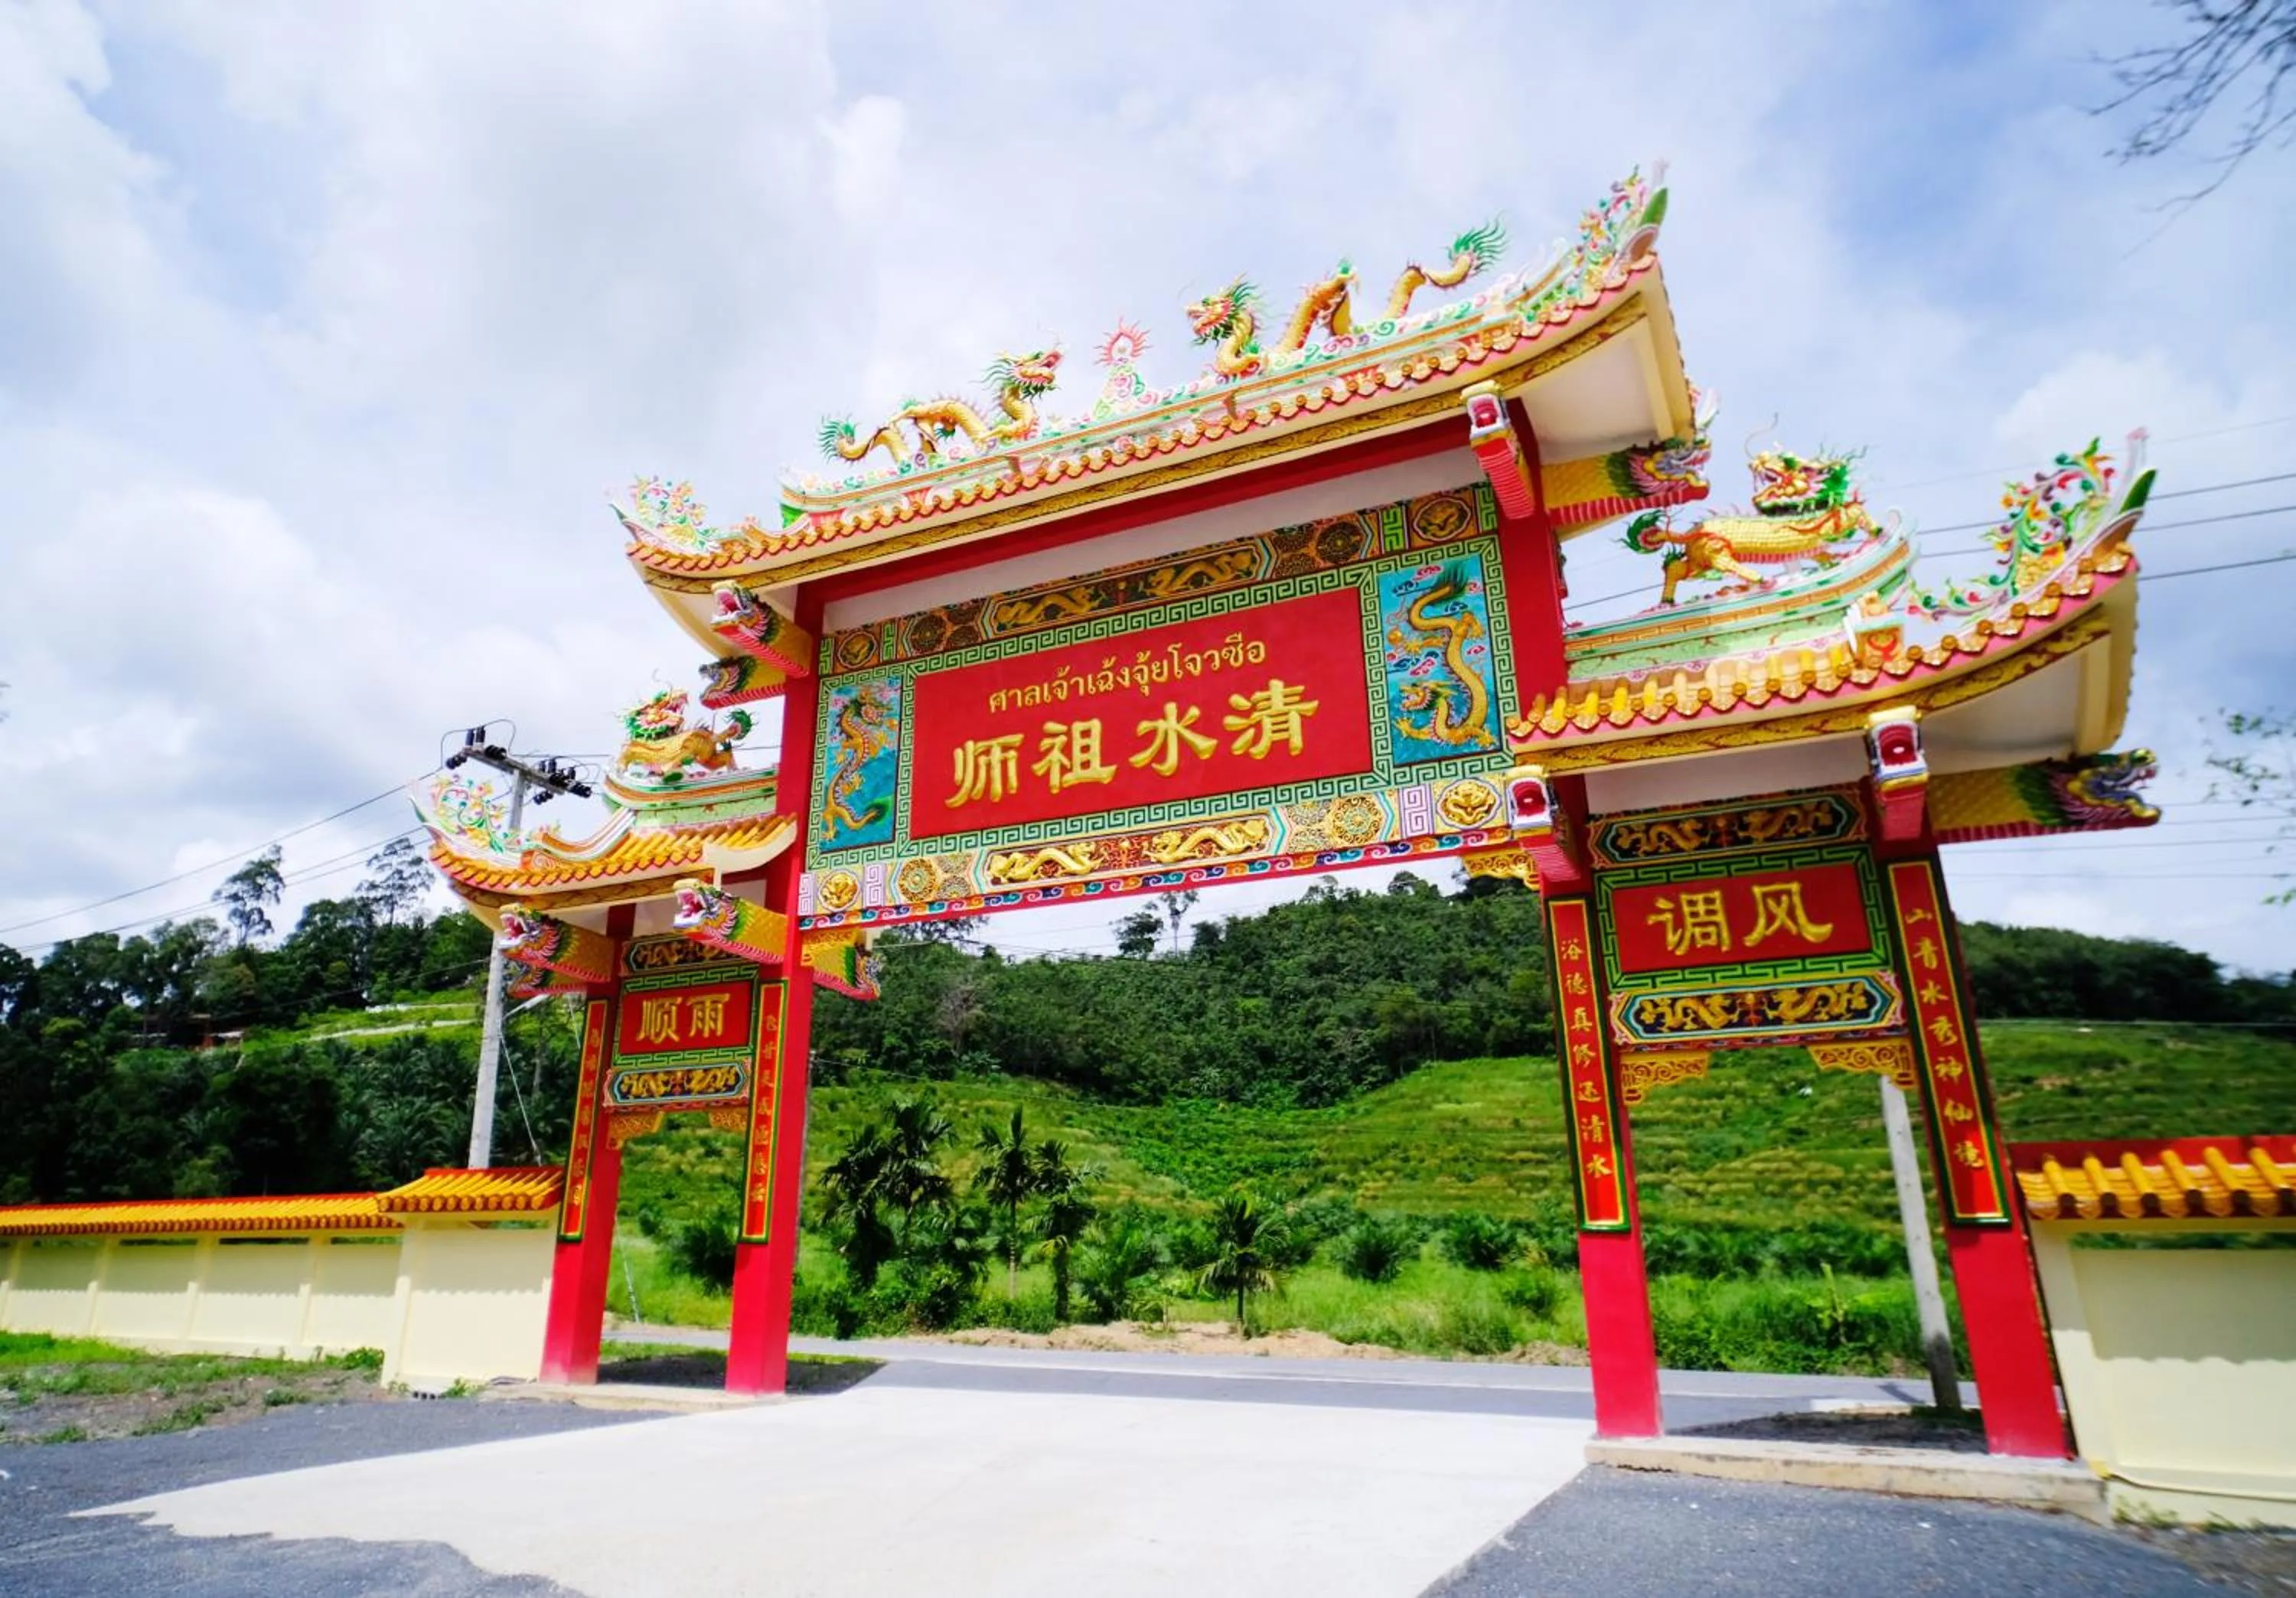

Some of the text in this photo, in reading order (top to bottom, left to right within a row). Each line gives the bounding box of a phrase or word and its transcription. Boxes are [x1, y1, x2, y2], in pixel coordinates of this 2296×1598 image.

[989, 632, 1266, 713] ศาลเจ้าเฉ้งจุ้ยโจวซือ
